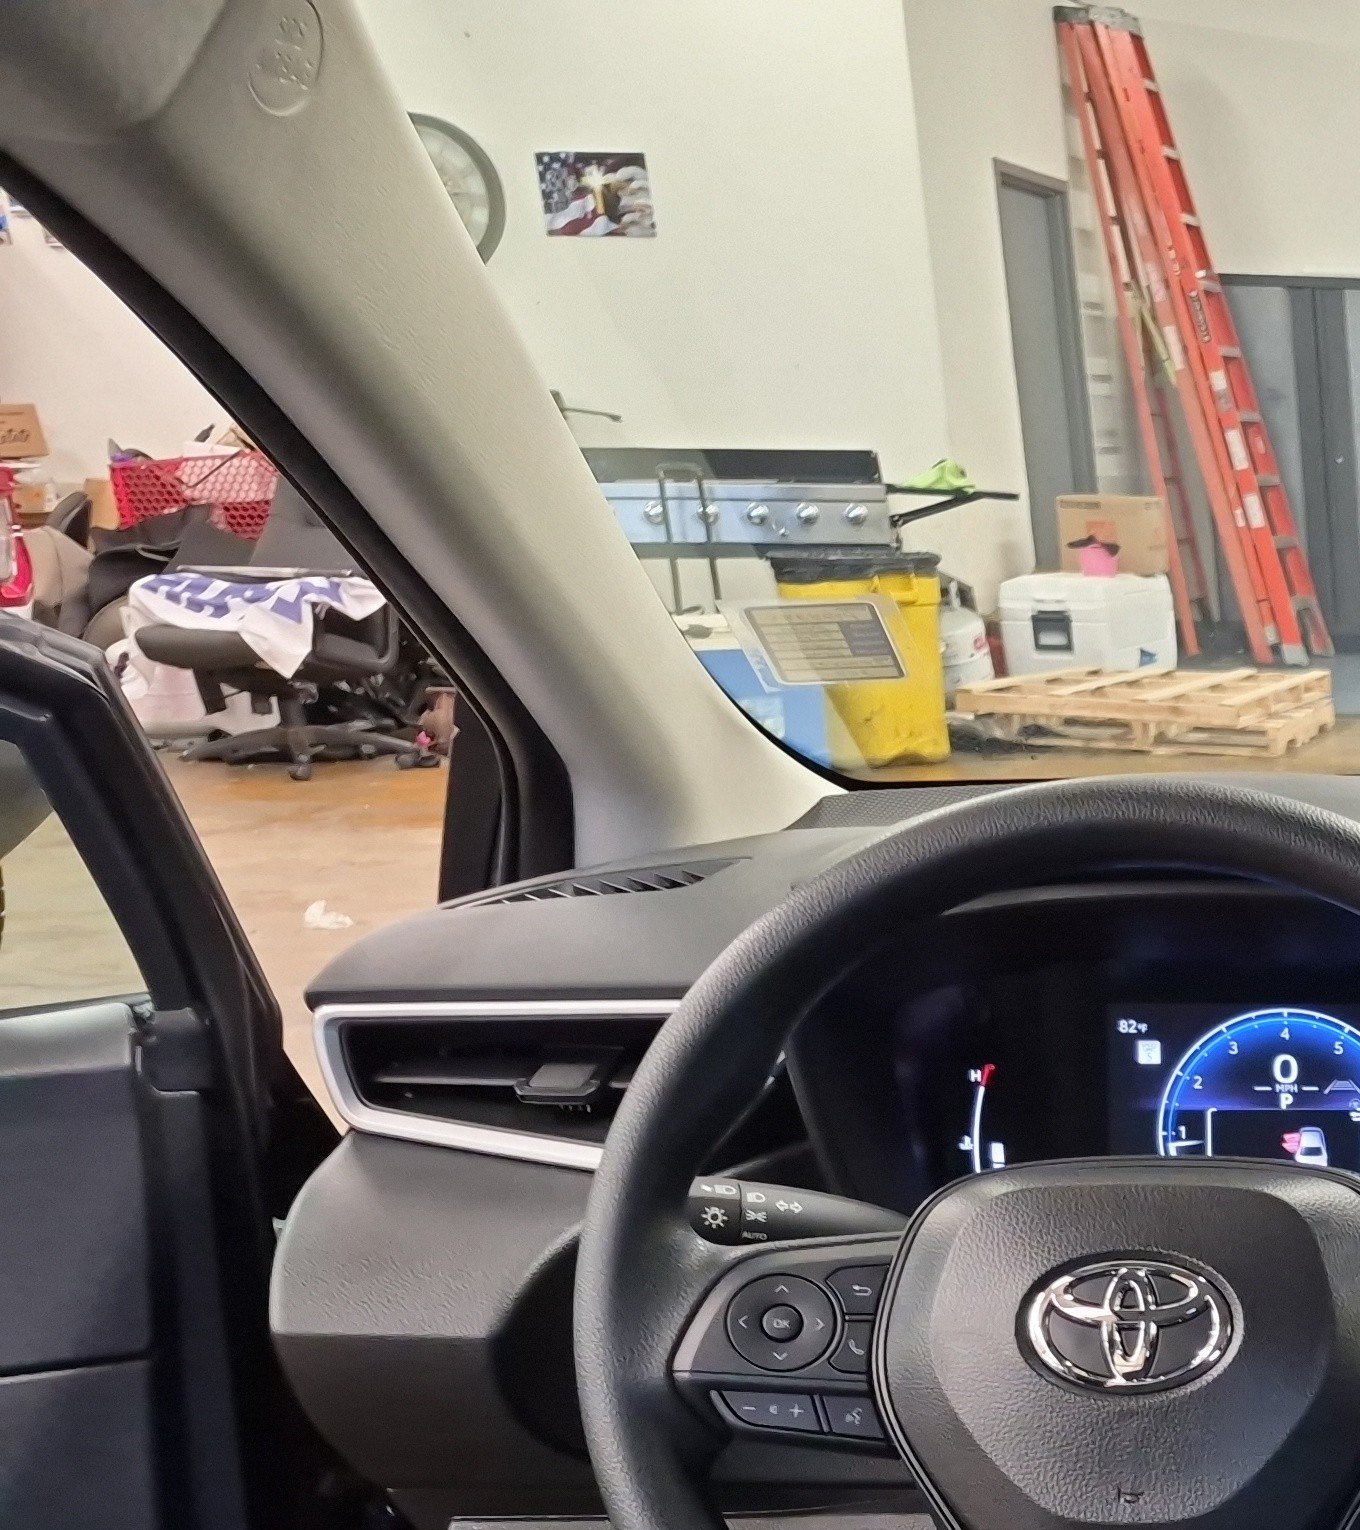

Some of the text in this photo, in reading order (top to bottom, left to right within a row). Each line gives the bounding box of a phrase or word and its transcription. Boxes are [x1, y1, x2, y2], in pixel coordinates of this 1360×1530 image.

[1279, 1027, 1290, 1041] 4
[1228, 1041, 1239, 1055] 3
[1333, 1041, 1344, 1055] 5
[968, 1068, 982, 1082] H
[1272, 1053, 1299, 1084] 0
[1193, 1075, 1204, 1089] 2
[1274, 1083, 1299, 1093] MPH
[1279, 1093, 1294, 1110] P
[1178, 1125, 1187, 1140] 1
